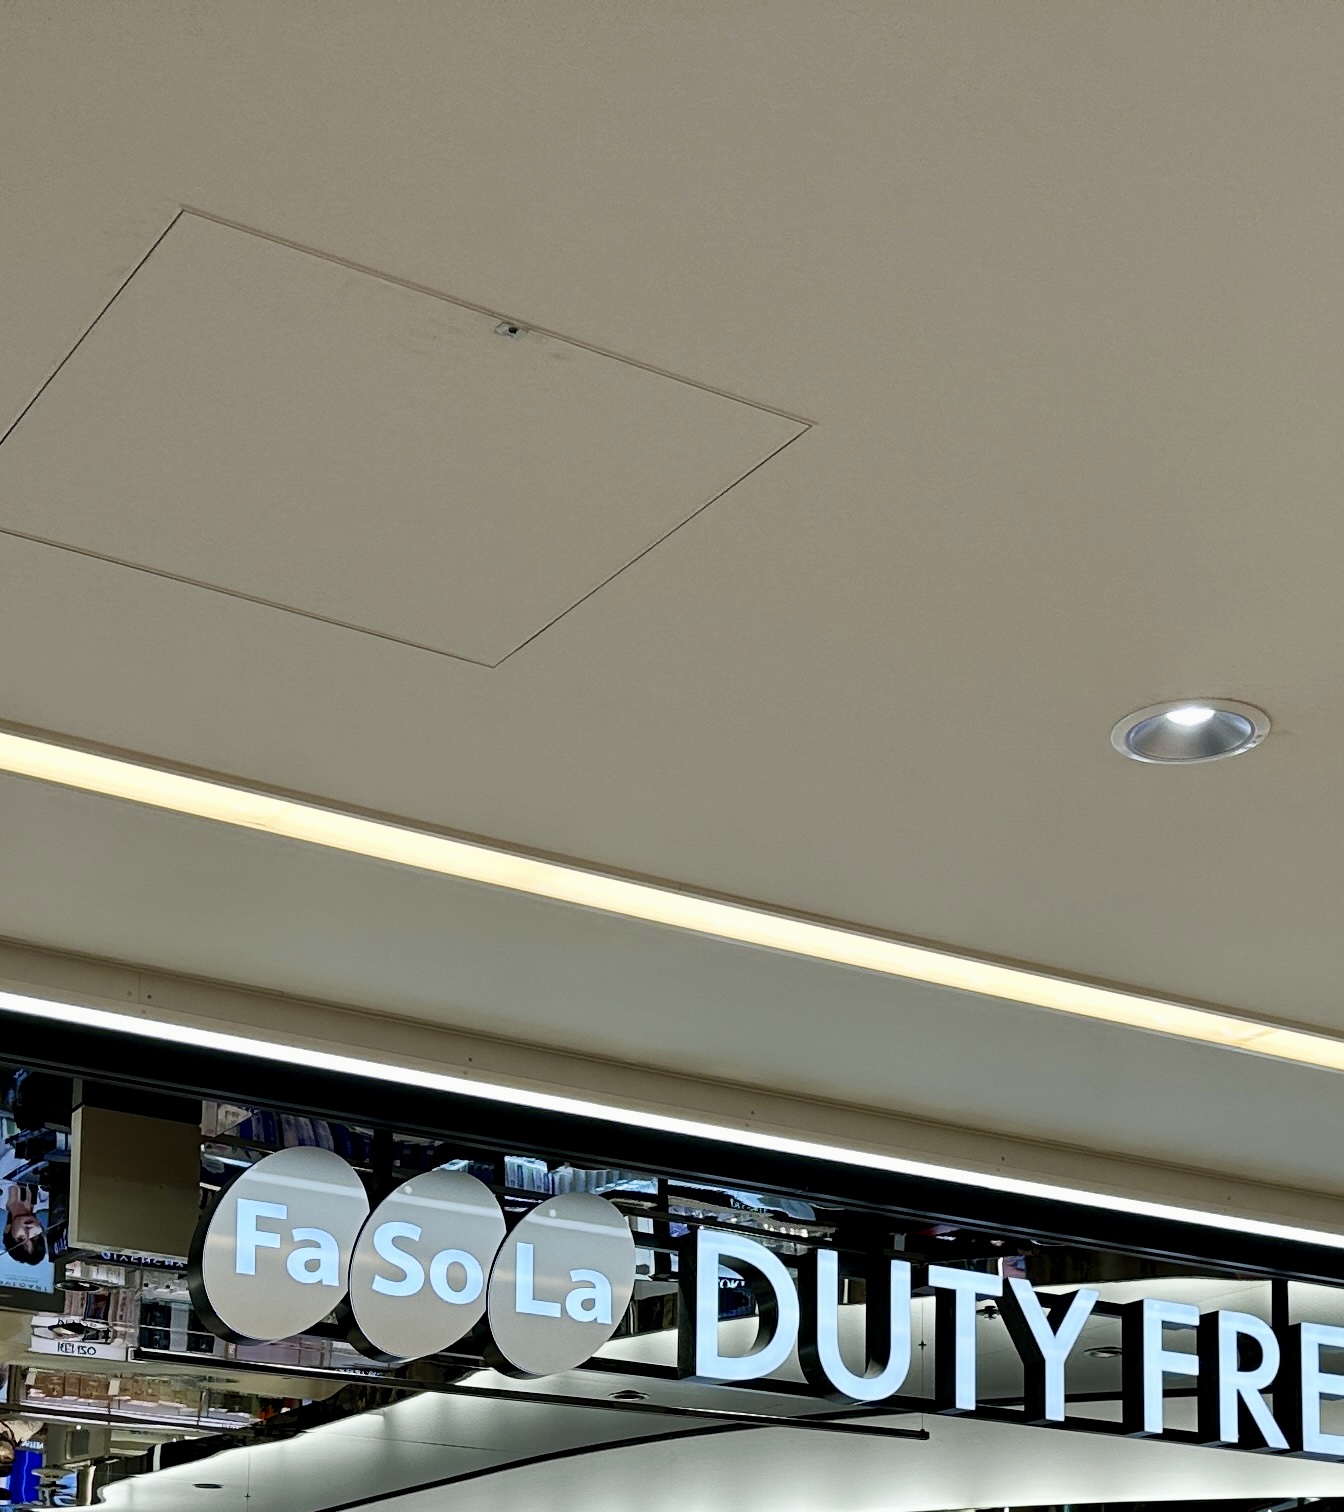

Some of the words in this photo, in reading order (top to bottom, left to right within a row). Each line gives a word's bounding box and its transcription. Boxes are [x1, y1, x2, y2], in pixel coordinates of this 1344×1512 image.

[235, 1197, 340, 1287] Fa
[372, 1221, 483, 1305] So
[514, 1241, 613, 1325] La
[696, 1228, 1100, 1422] DUTY
